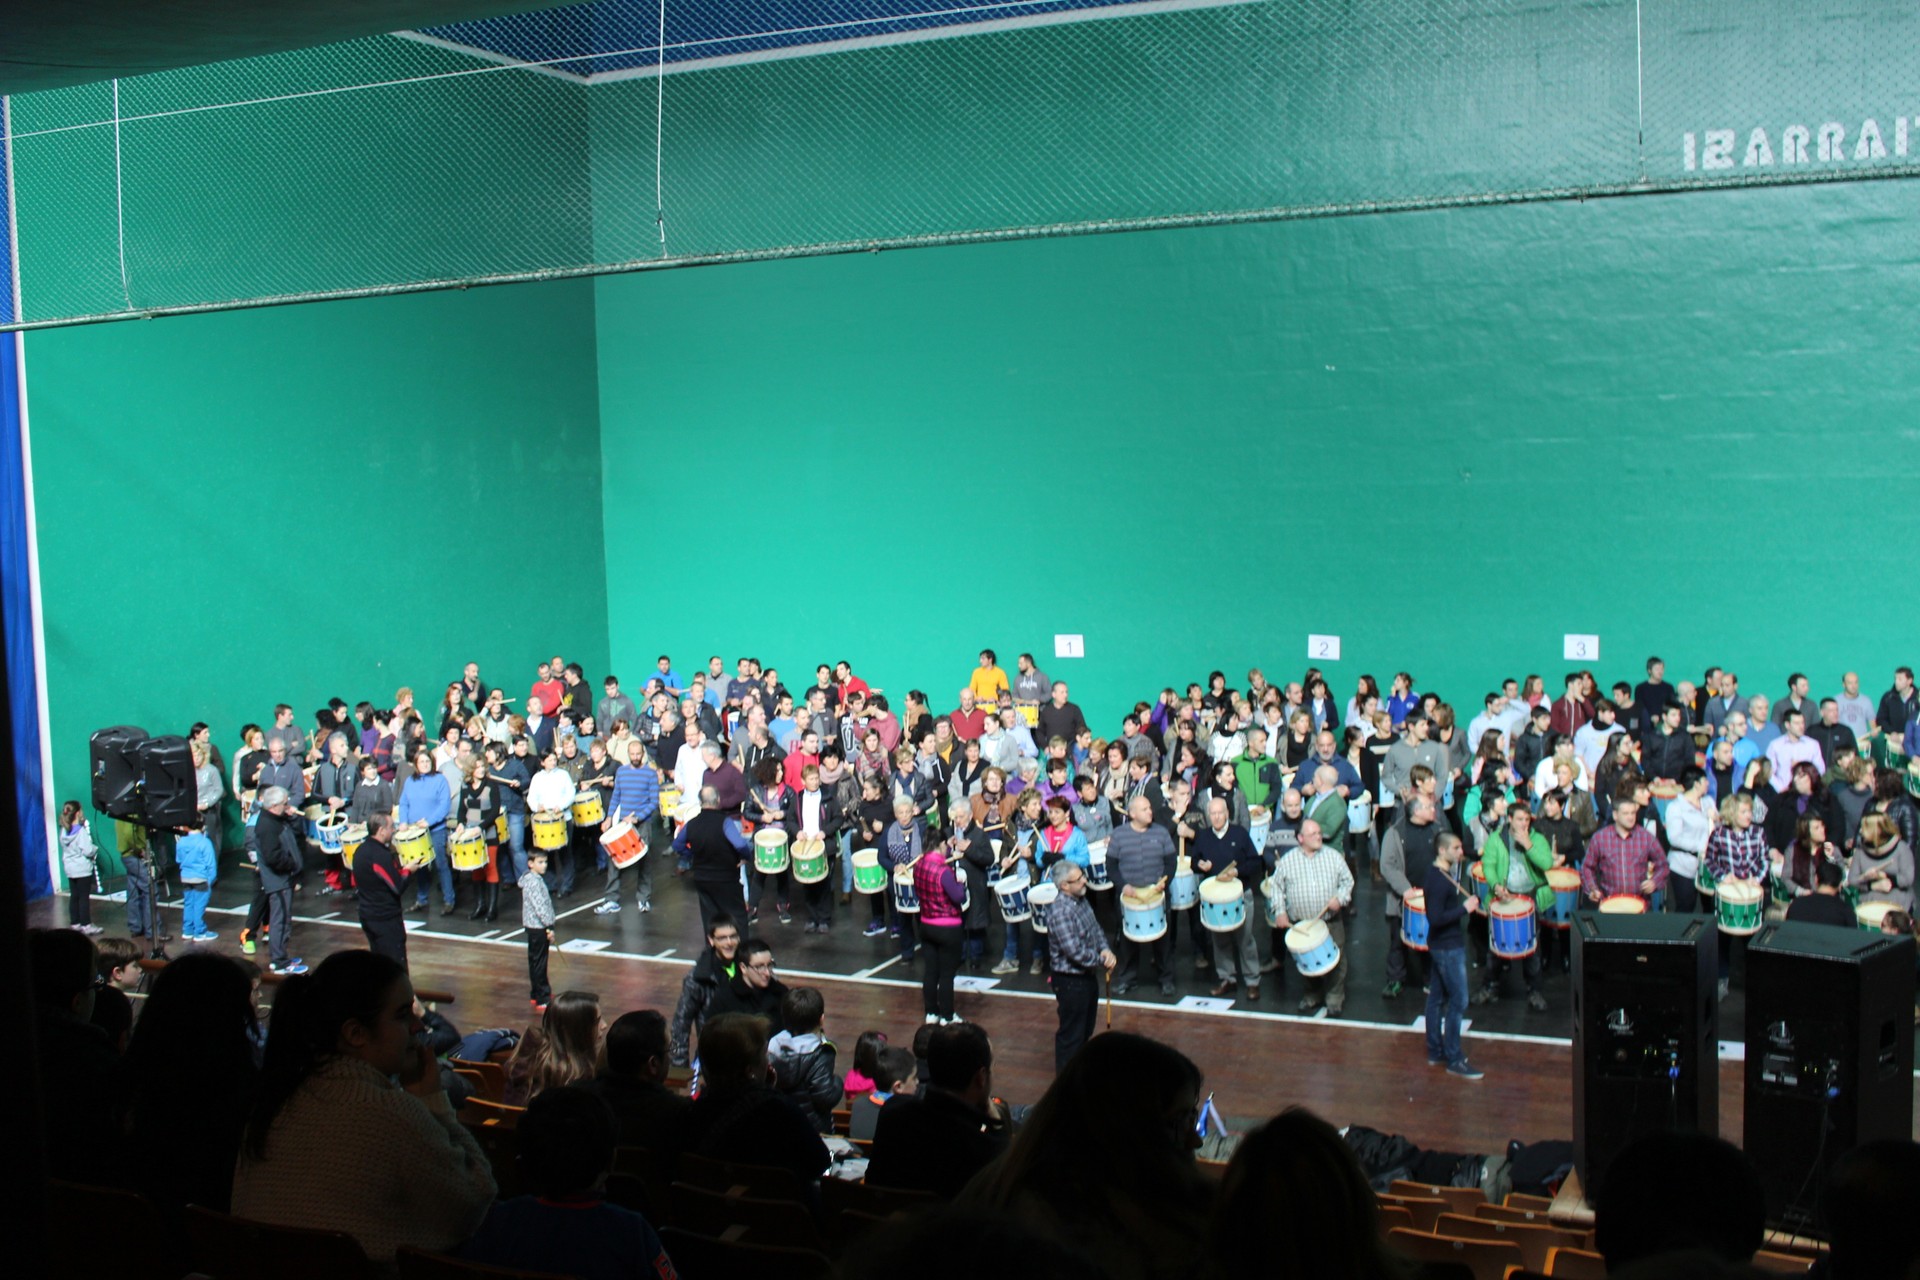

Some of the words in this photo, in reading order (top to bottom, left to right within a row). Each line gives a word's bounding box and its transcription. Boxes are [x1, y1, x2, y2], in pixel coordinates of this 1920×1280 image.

[1066, 641, 1072, 655] 1
[1319, 640, 1329, 657] 2
[1576, 640, 1586, 658] 3
